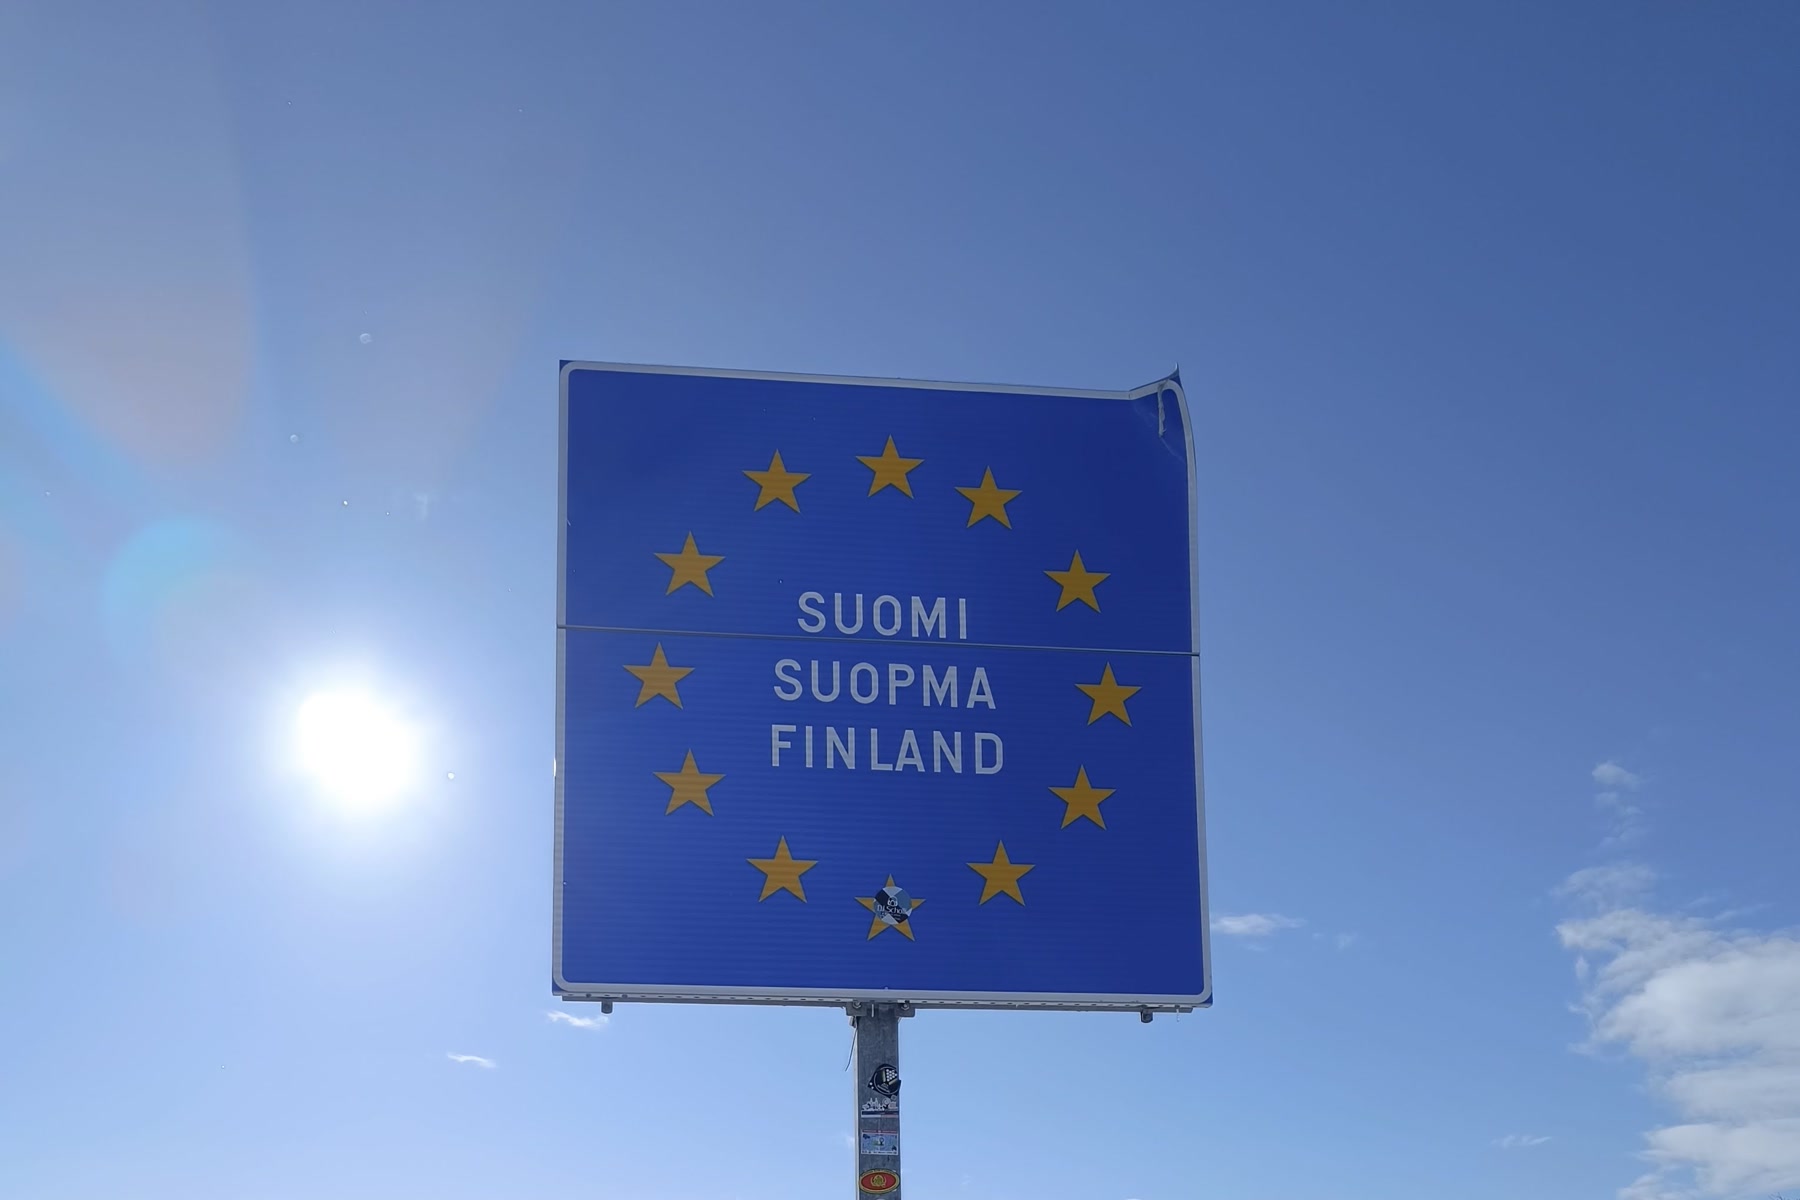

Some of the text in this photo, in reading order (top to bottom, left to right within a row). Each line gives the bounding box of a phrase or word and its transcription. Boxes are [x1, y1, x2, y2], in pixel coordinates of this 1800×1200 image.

[797, 591, 967, 640] SUOMI
[773, 658, 996, 710] SUOPMA
[771, 724, 1004, 775] FINLAND
